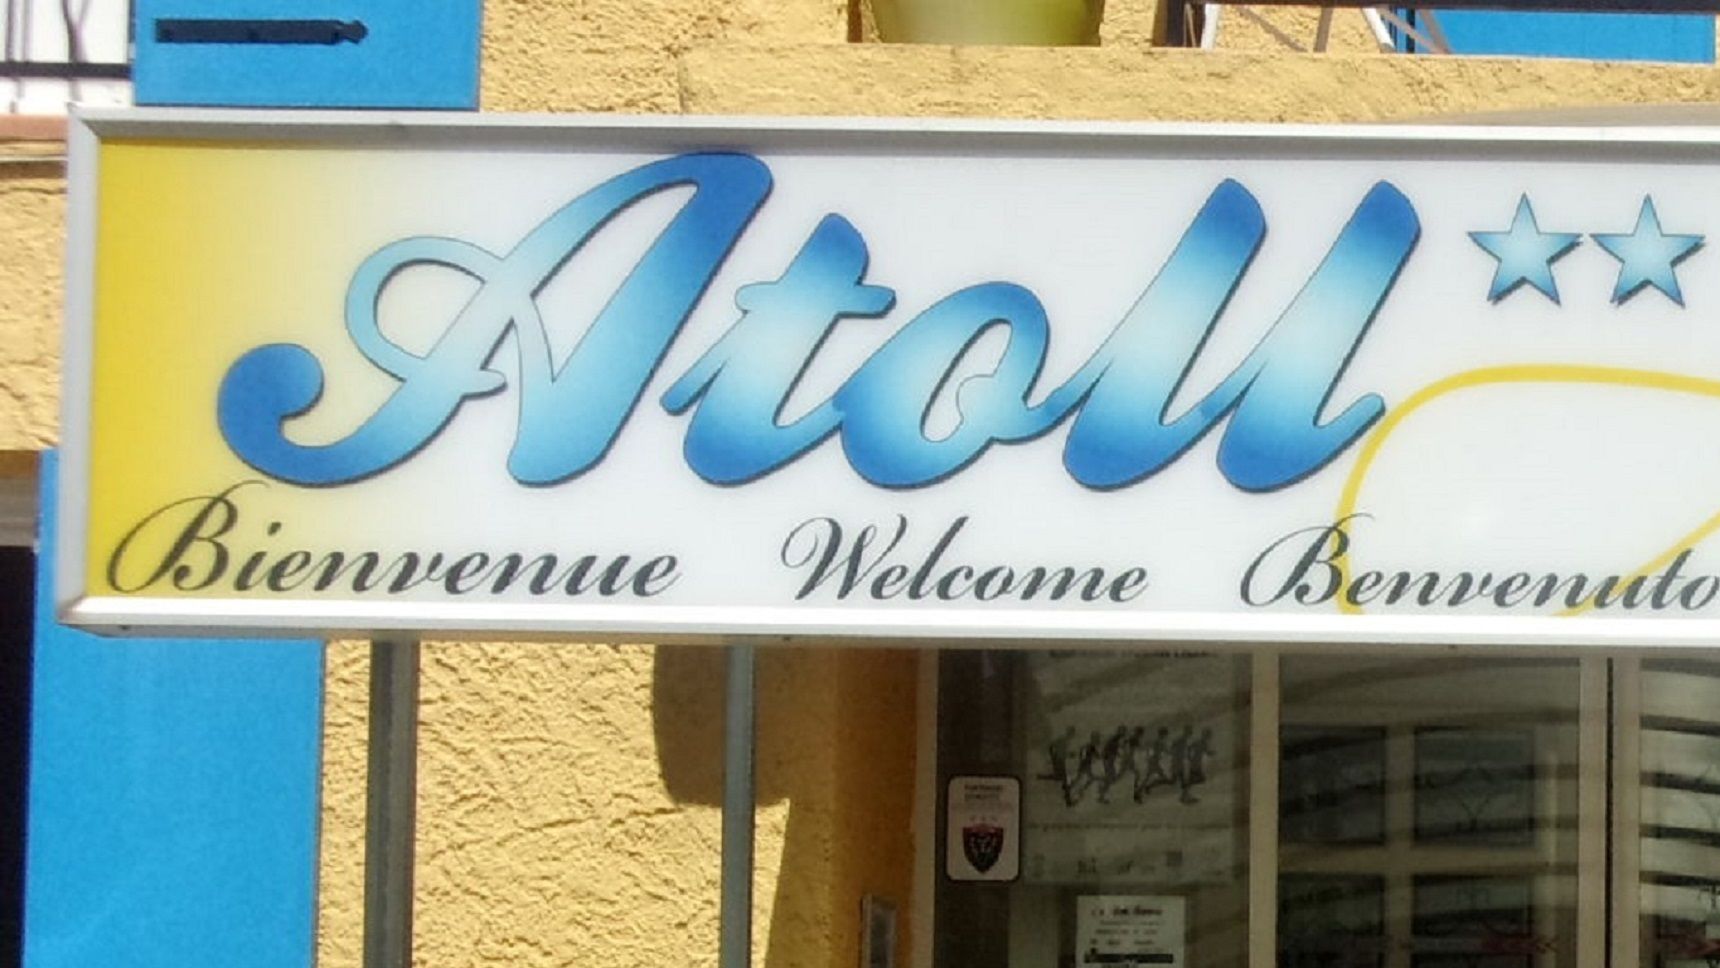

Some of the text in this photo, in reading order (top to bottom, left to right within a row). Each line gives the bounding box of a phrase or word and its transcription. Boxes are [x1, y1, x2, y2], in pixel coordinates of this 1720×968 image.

[216, 150, 1421, 492] Atoll
[106, 480, 681, 597] Bienvenue
[781, 512, 1149, 601] Welcome
